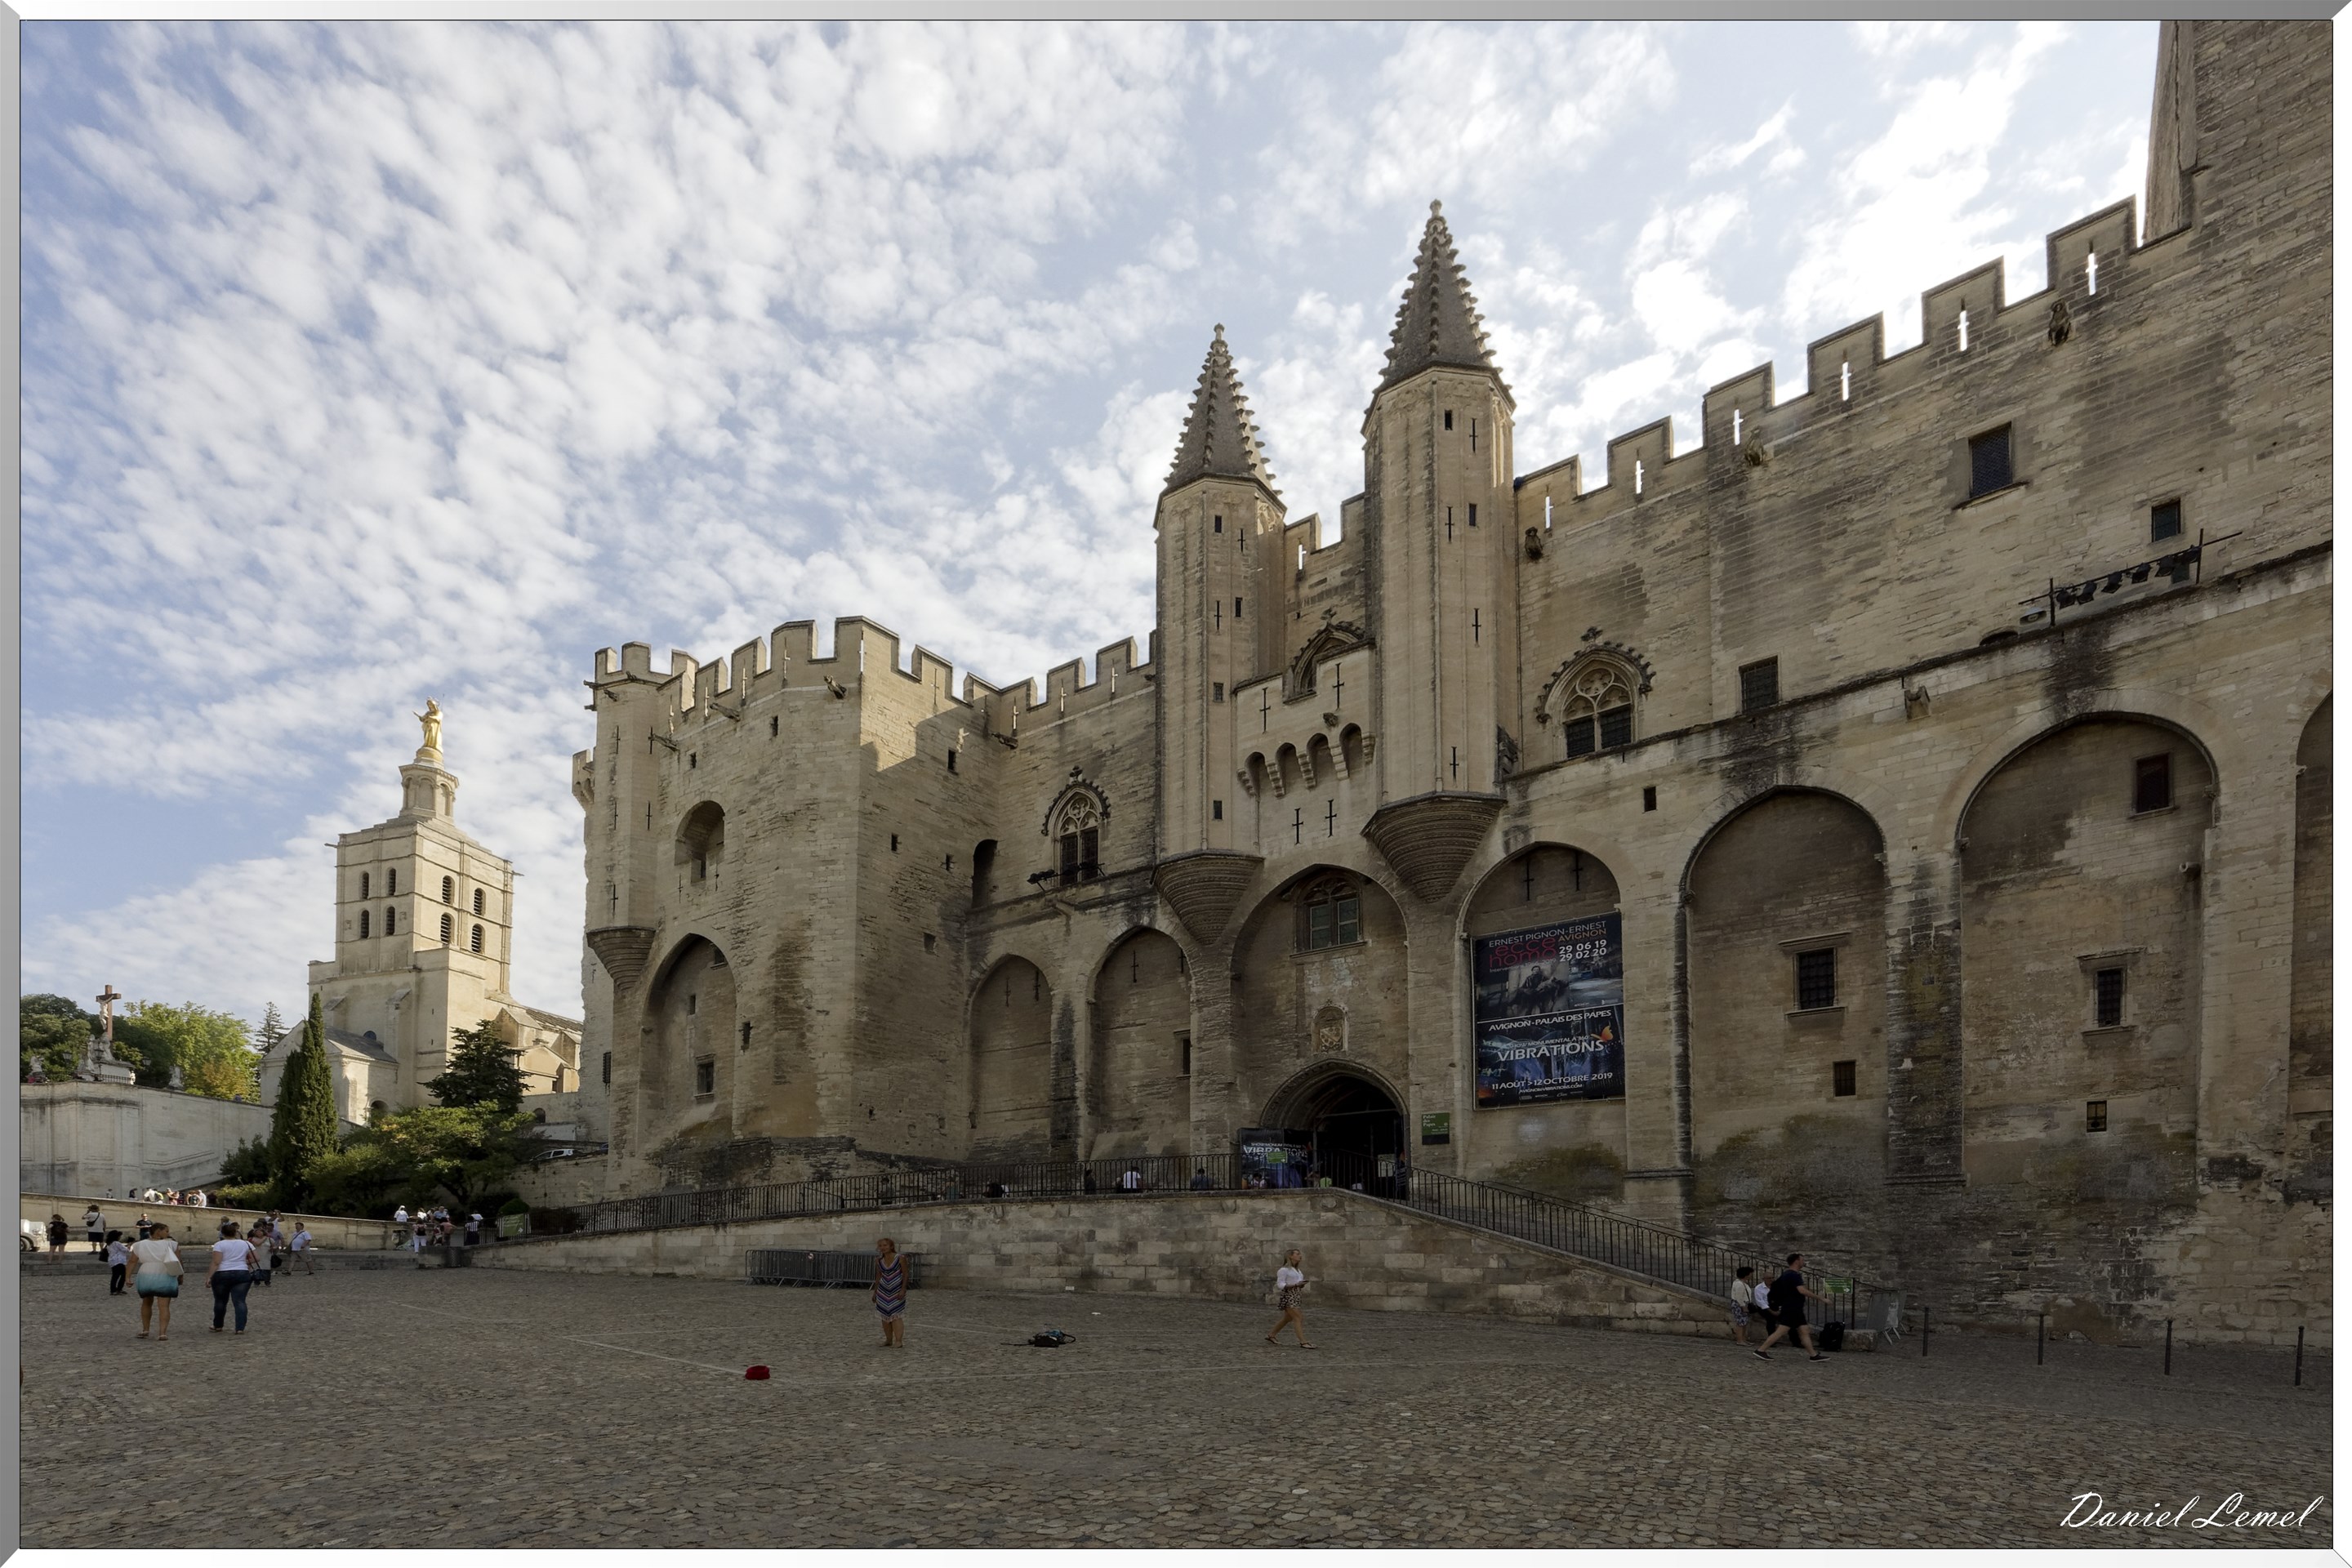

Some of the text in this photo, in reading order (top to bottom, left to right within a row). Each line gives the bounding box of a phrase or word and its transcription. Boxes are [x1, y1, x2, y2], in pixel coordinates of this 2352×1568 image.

[1489, 936, 1524, 947] ERNEST
[1558, 928, 1607, 942] AVIGNON
[1494, 938, 1556, 956] ecce
[1559, 939, 1607, 955] 29 06 19
[1559, 952, 1573, 962] 29
[1575, 950, 1590, 960] 02
[1592, 947, 1607, 957] 20
[1489, 947, 1557, 968] homo
[1566, 1013, 1584, 1022] DES
[1584, 1009, 1612, 1019] PAPES
[1528, 1036, 1571, 1046] MONUMENTAL
[1497, 1040, 1605, 1062] VIBRATIONS
[1499, 1078, 1526, 1090] AOÛT
[1533, 1079, 1543, 1087] 12
[1543, 1075, 1589, 1085] OCTOBRE
[1591, 1072, 1613, 1081] 2019
